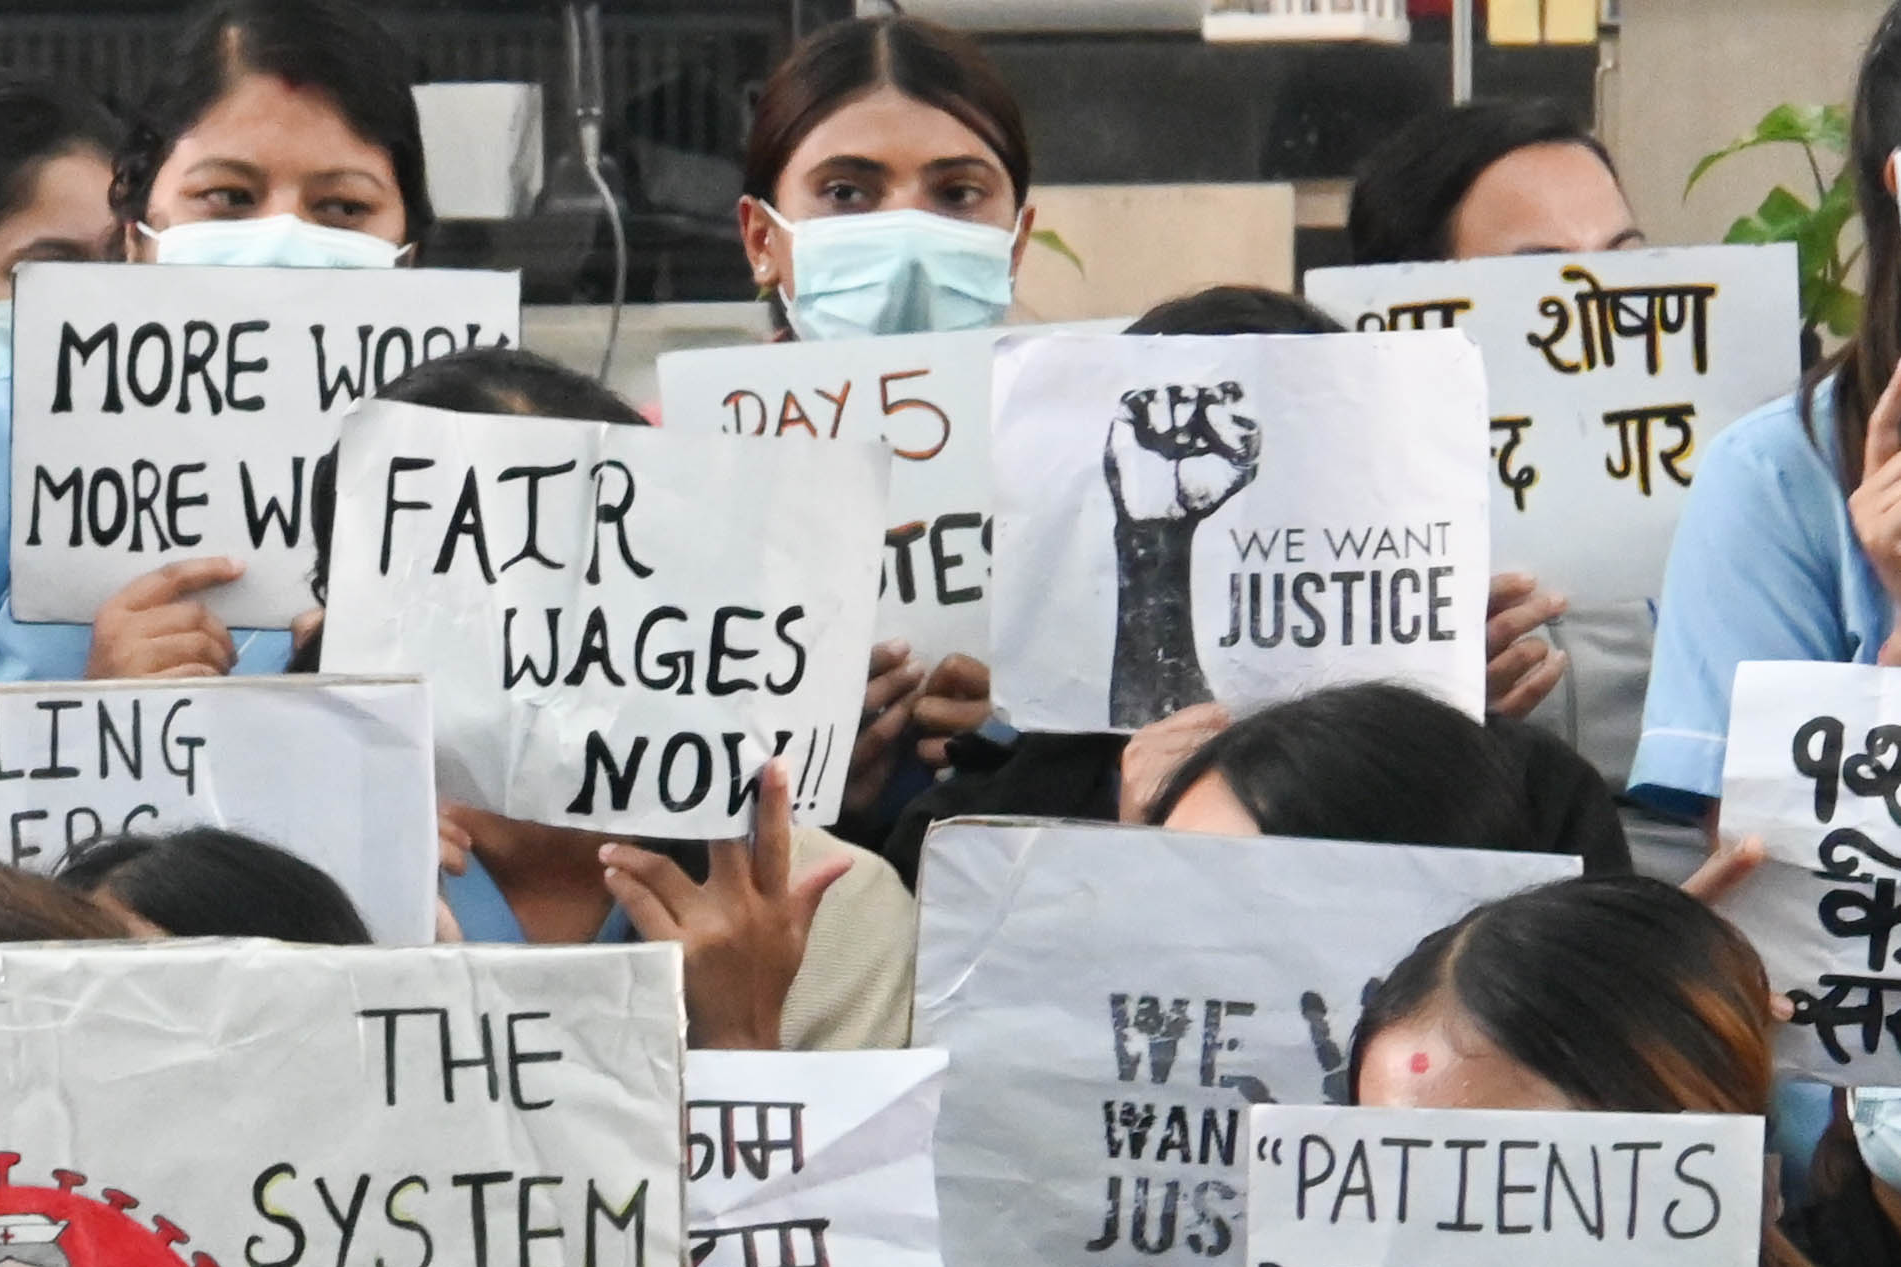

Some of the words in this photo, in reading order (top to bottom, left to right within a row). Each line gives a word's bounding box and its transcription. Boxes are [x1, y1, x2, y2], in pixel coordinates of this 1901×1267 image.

[1526, 264, 1720, 376] शोषण
[52, 320, 270, 415] MORE
[310, 323, 509, 412] WO
[722, 379, 852, 440] DAY
[879, 368, 951, 461] 5
[27, 458, 208, 553] MORE
[380, 457, 655, 585] FAIR
[1229, 528, 1305, 563] WE
[1324, 521, 1452, 561] WANT
[503, 604, 806, 695] WAGES
[1218, 566, 1457, 649] JUSTICE
[356, 1007, 563, 1110] THE
[1101, 1100, 1238, 1166] WAN
[1085, 1177, 1239, 1257] JUS
